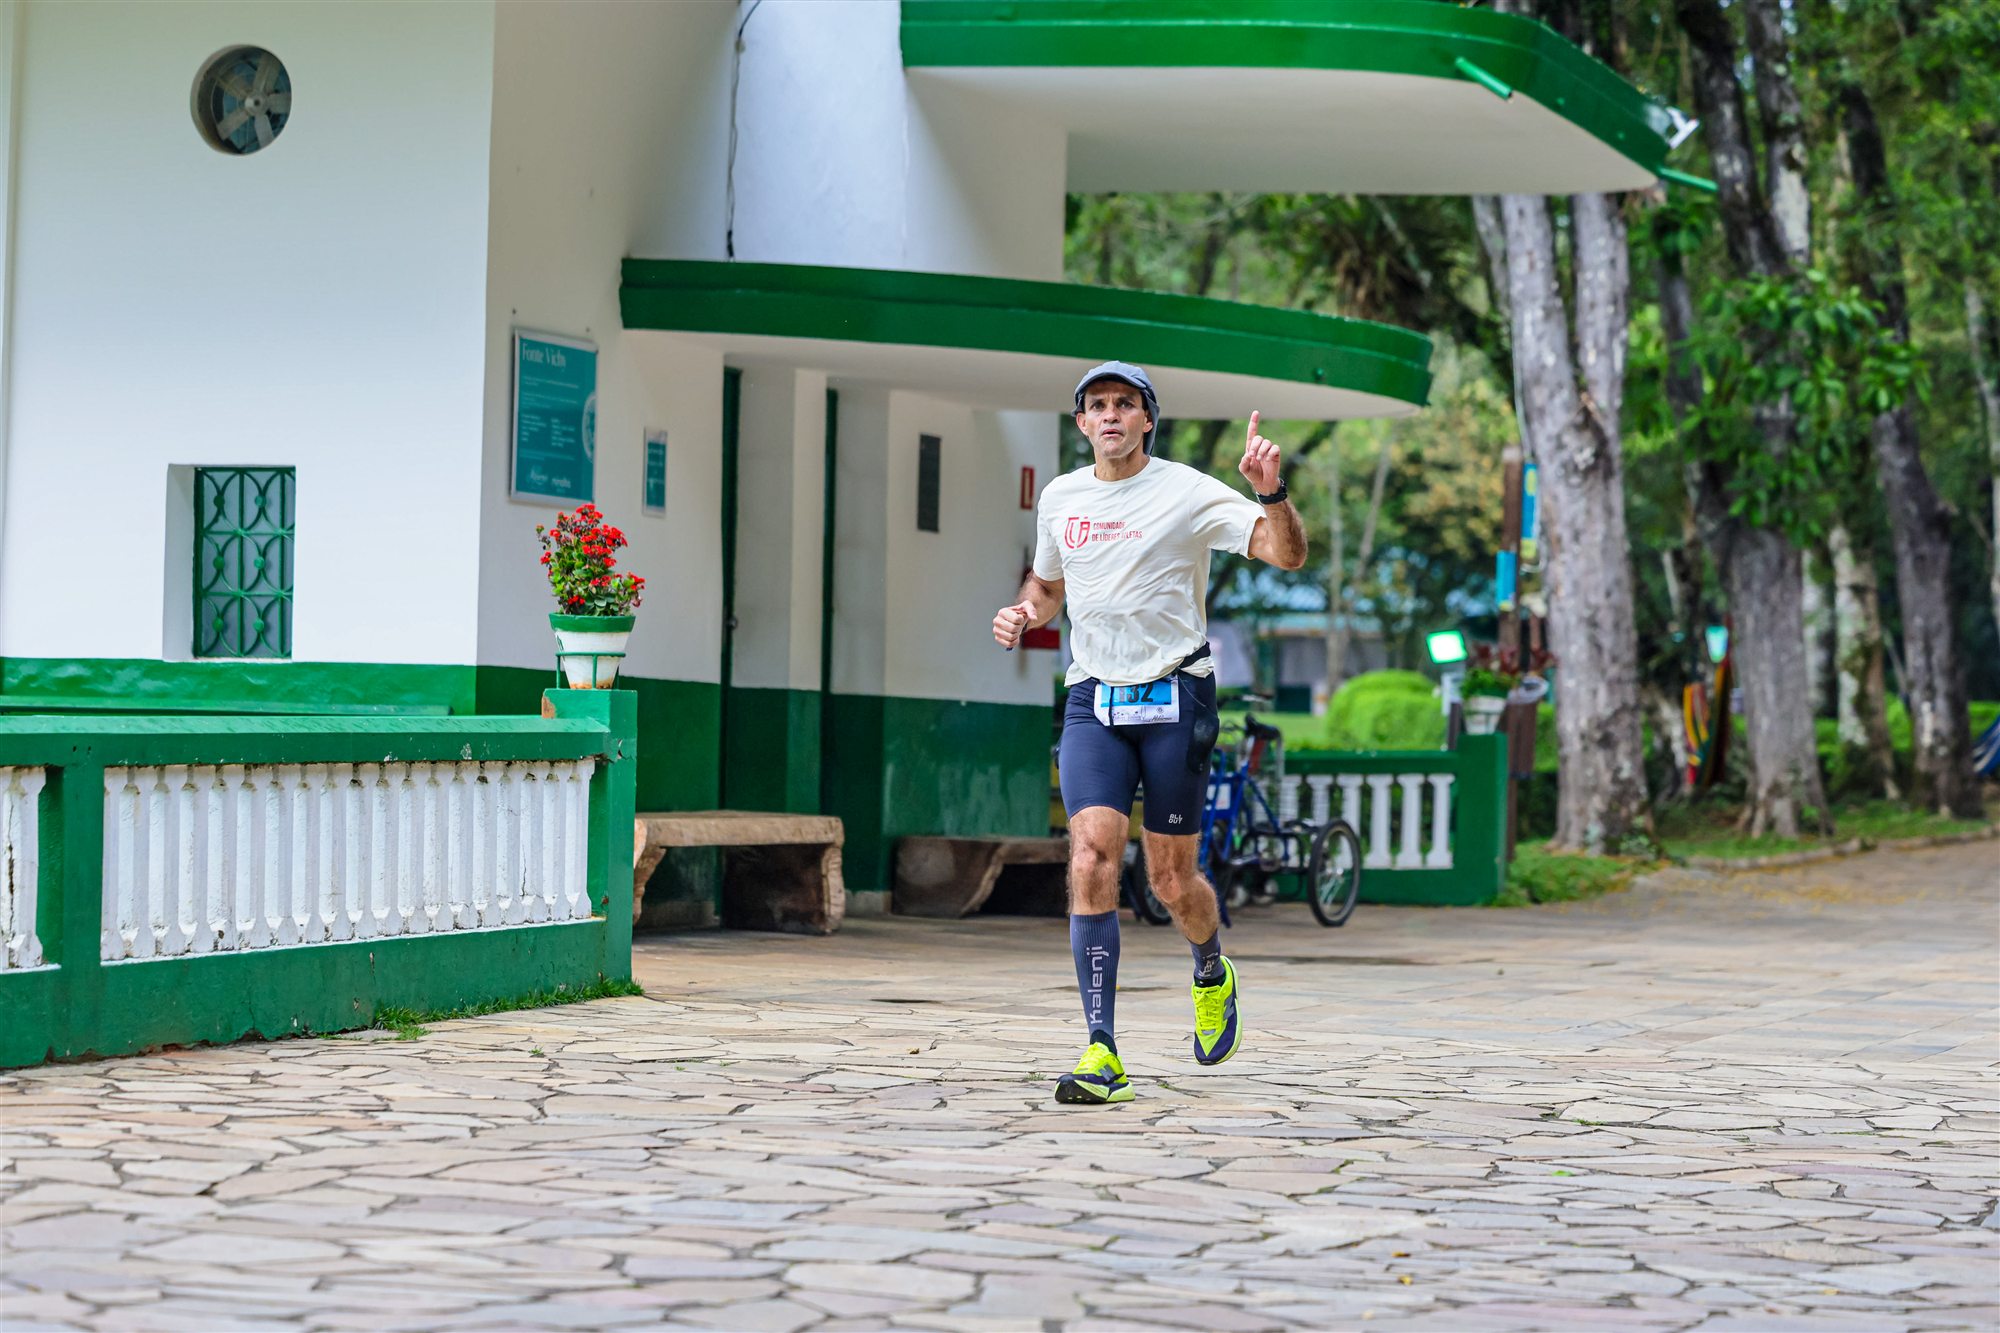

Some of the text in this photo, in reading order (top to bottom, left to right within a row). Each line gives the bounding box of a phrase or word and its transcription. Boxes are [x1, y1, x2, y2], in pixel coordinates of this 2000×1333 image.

[522, 342, 544, 363] Fonte
[1091, 533, 1099, 542] DE
[1121, 530, 1143, 540] LETAS
[1119, 682, 1154, 703] 132
